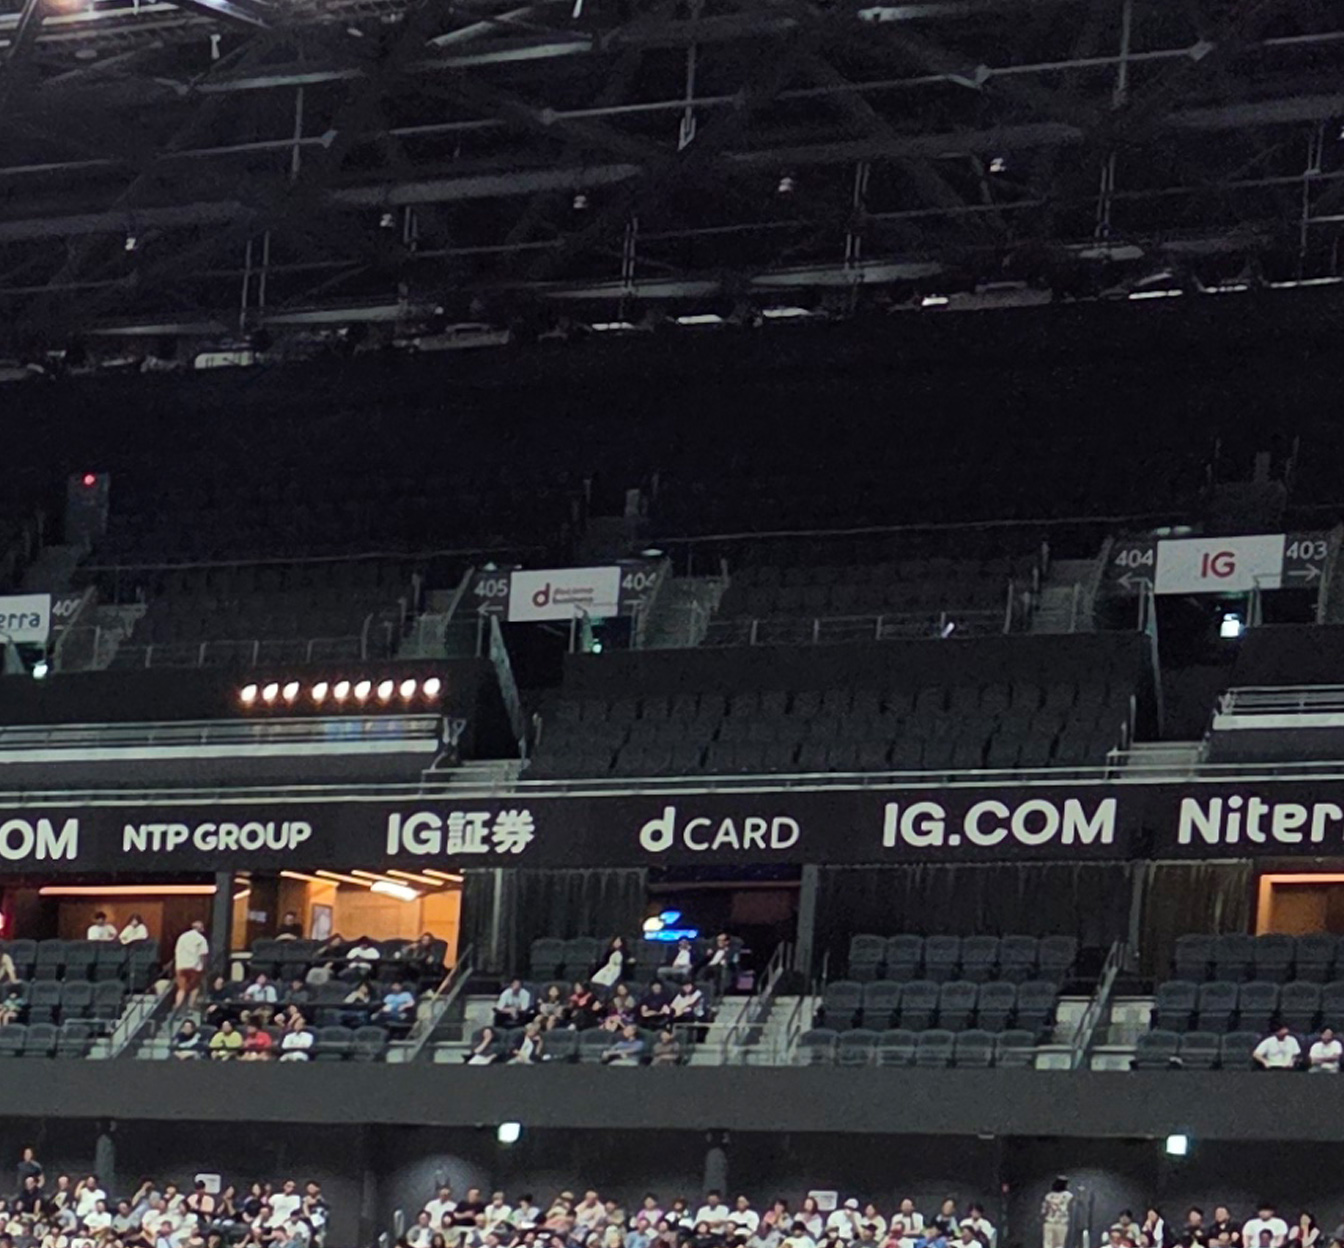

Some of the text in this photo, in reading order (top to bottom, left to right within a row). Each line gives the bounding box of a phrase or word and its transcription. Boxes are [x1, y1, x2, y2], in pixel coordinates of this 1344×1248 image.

[1116, 549, 1154, 567] 404
[1201, 551, 1236, 578] IG
[1286, 541, 1328, 560] 403
[474, 579, 508, 597] 405
[122, 821, 312, 852] NTP GROUP
[386, 809, 536, 855] IG証券
[683, 816, 800, 851] CARD
[882, 798, 1117, 848] IG.COM
